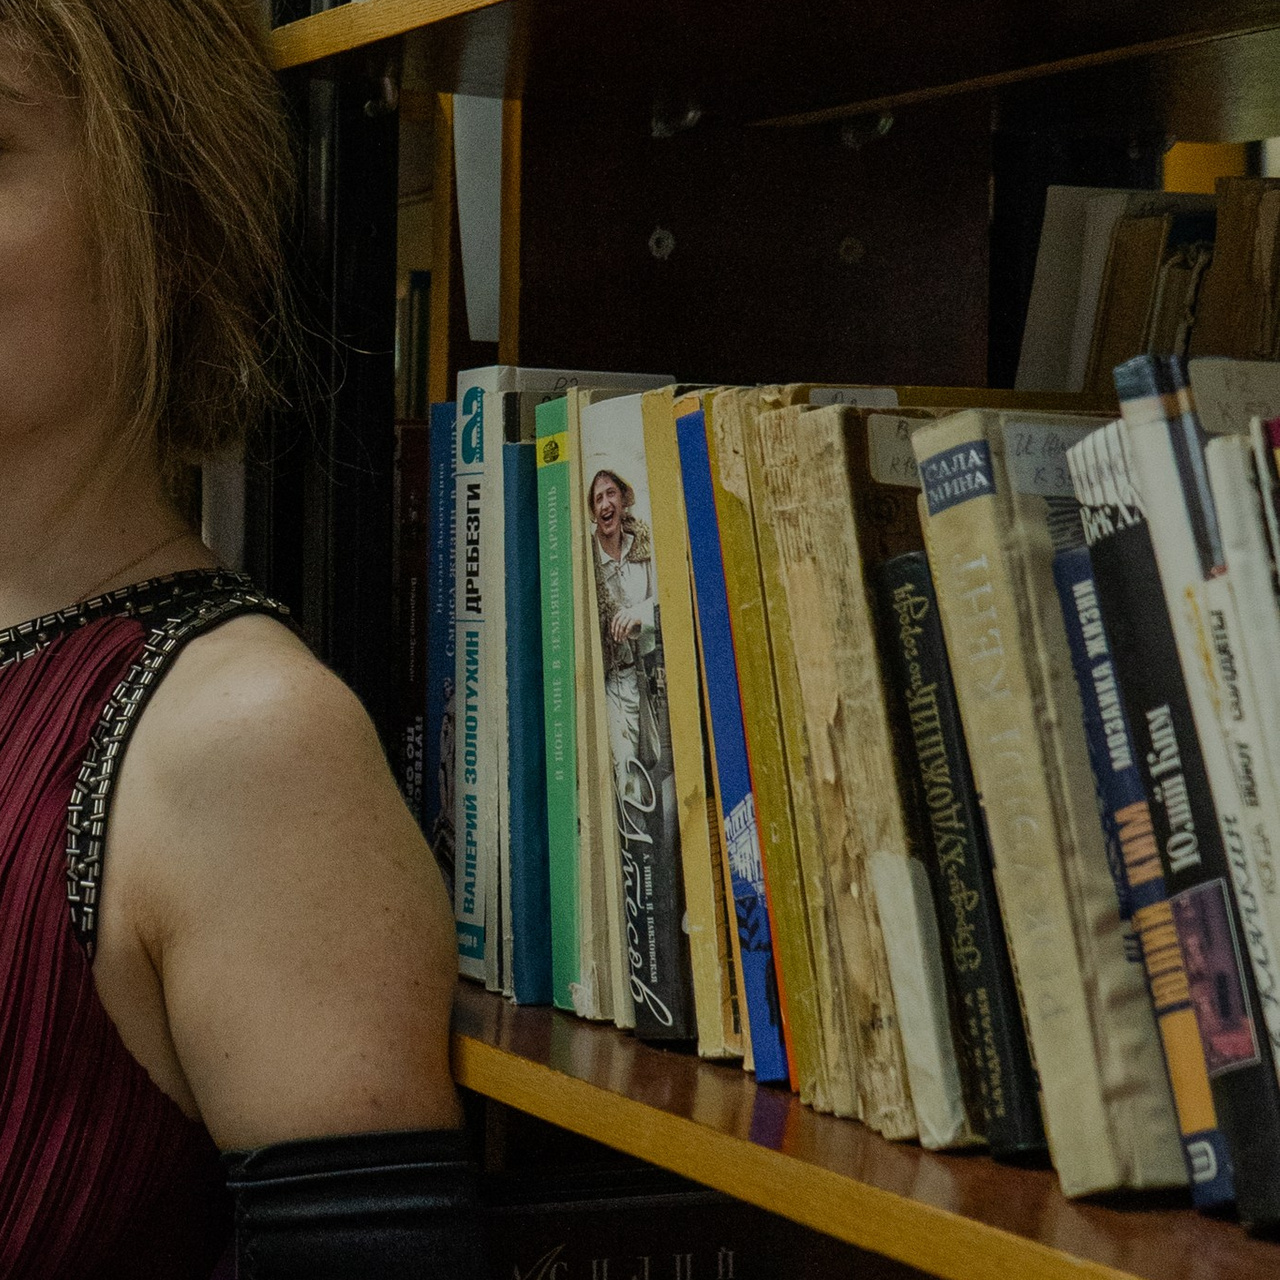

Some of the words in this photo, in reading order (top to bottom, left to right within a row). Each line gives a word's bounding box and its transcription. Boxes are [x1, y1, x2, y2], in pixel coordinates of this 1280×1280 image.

[927, 469, 991, 505] МИНА
[464, 483, 482, 613] ДРЕБЕЗГИ
[949, 552, 1011, 703] КЕНТ
[1071, 578, 1110, 659] ЖИЗНИ
[463, 630, 479, 785] ЗОЛОТУХИН
[1091, 660, 1133, 771] МОЗАИКА
[1144, 703, 1182, 777] Ким
[906, 682, 968, 873] ХУДОЖНИК
[1152, 776, 1202, 873] Юлий
[461, 794, 478, 915] ВАЛЕРИЙ
[1112, 799, 1164, 887] КИМ
